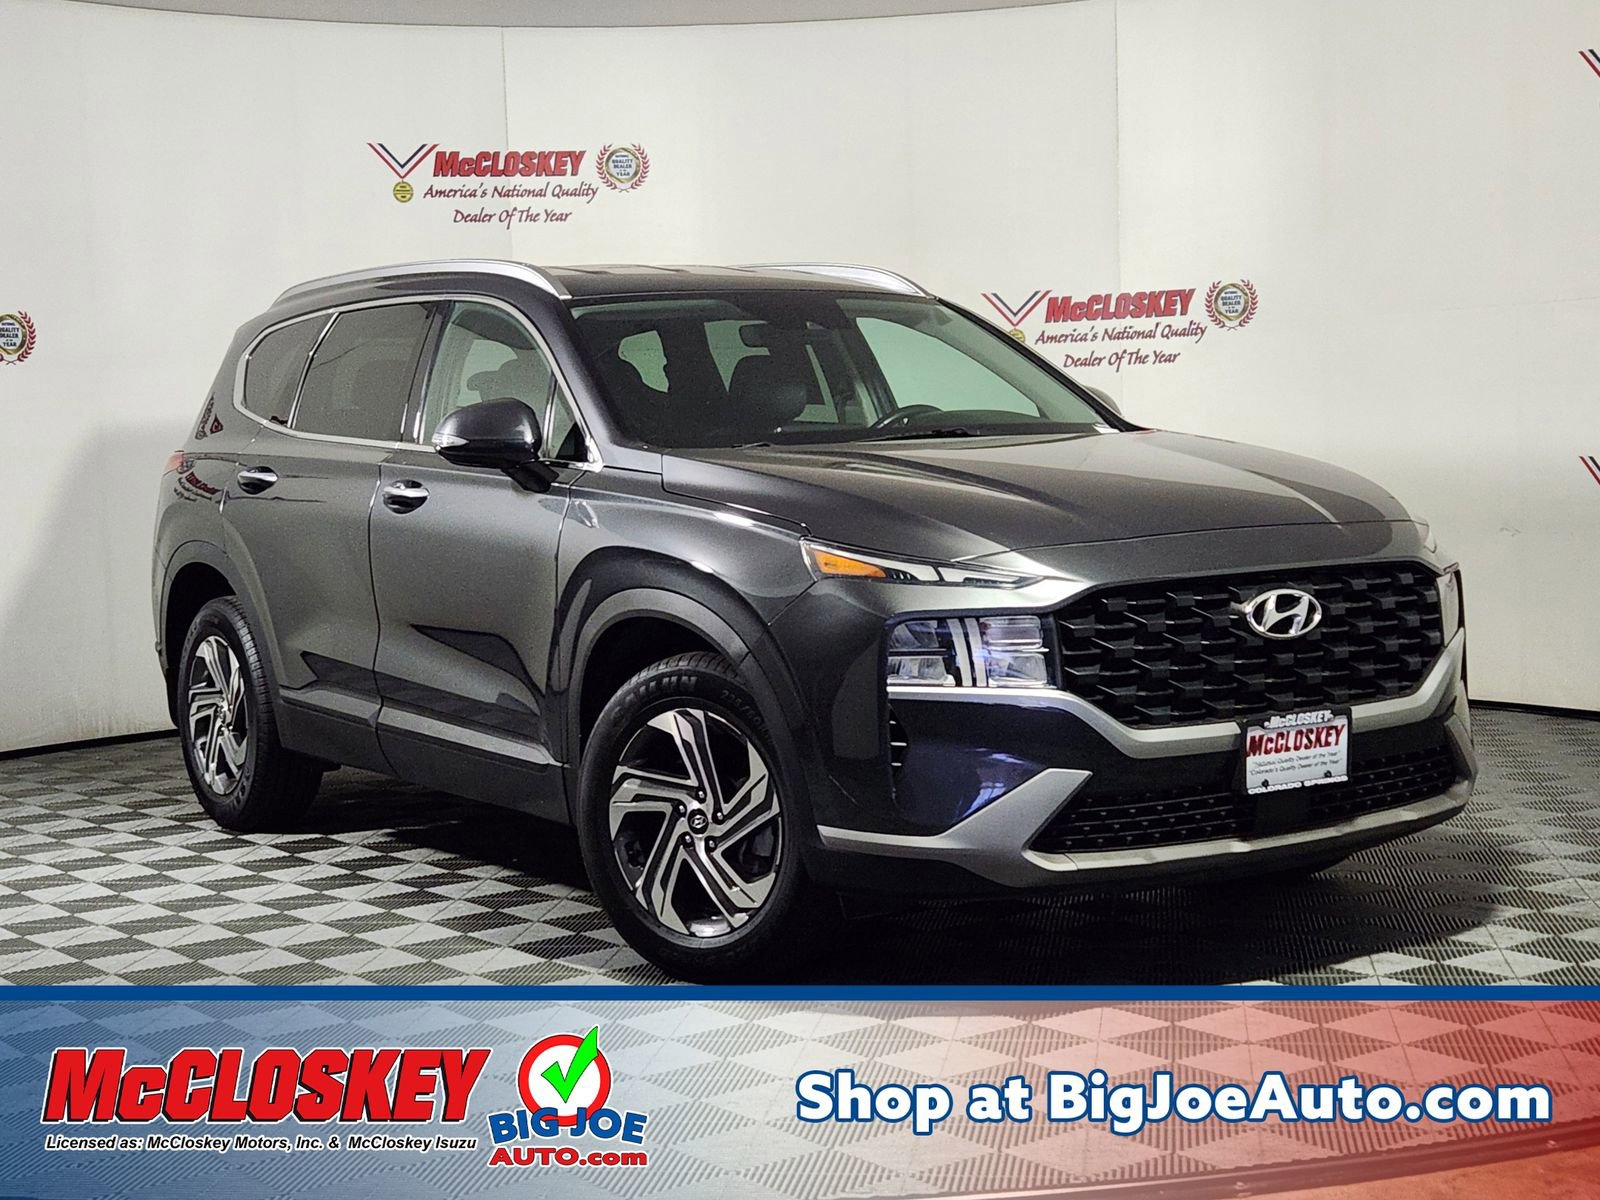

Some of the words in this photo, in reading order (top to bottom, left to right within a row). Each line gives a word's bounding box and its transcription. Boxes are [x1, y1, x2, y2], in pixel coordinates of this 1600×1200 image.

[432, 150, 587, 178] McCLOSKEY
[423, 183, 487, 199] America's
[491, 181, 547, 198] National
[551, 181, 599, 204] Quality
[453, 207, 496, 223] Dealer
[498, 207, 517, 230] Of
[517, 207, 541, 223] The
[542, 208, 573, 223] Year
[1044, 288, 1197, 324] McCLOSKEY
[1034, 326, 1098, 345] America's
[1101, 323, 1159, 342] National
[1161, 320, 1208, 344] Quality
[1063, 352, 1106, 369] Dealer
[1108, 349, 1126, 373] Of
[1126, 349, 1150, 366] The
[1152, 350, 1181, 365] Year
[1246, 724, 1346, 757] McCLOSKEY
